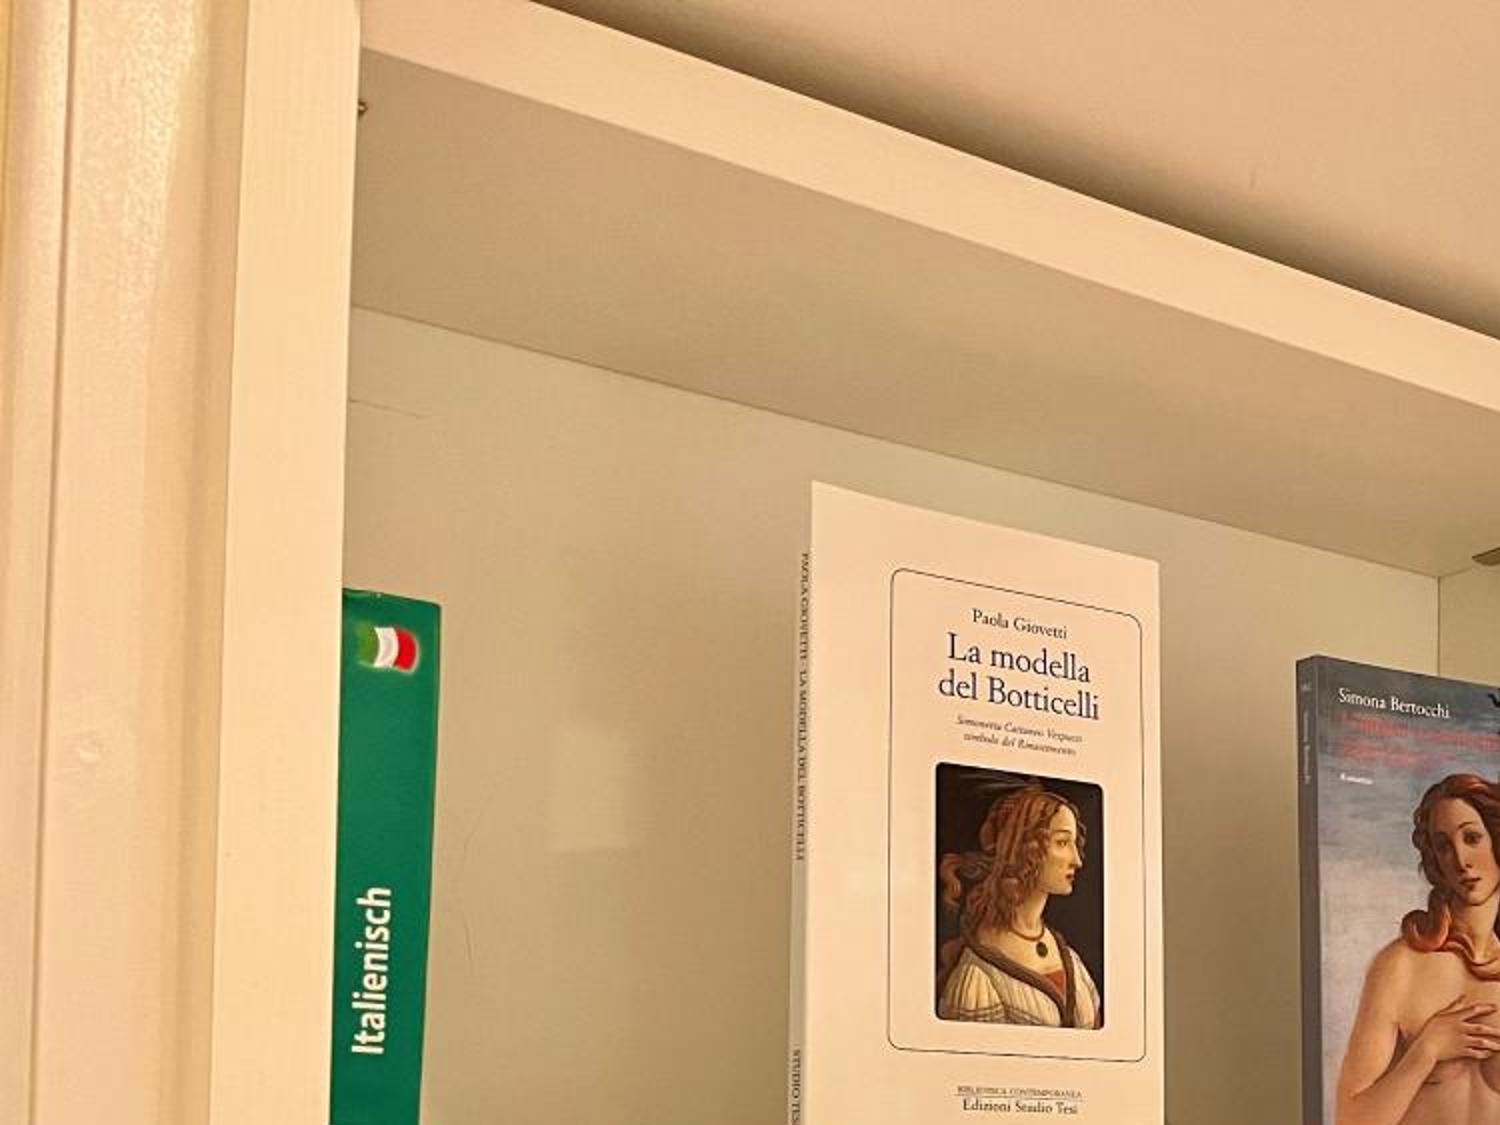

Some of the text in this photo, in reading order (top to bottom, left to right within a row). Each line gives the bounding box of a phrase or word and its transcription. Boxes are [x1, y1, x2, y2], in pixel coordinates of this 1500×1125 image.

[972, 608, 1068, 639] Paola Giovetti
[947, 632, 1091, 683] La modella
[938, 668, 1100, 721] del Botticelli
[1338, 687, 1451, 719] Simona Bertocchi
[351, 887, 392, 1055] Italienisch
[962, 1099, 1011, 1113] Edizioni
[1015, 1100, 1054, 1113] Studio
